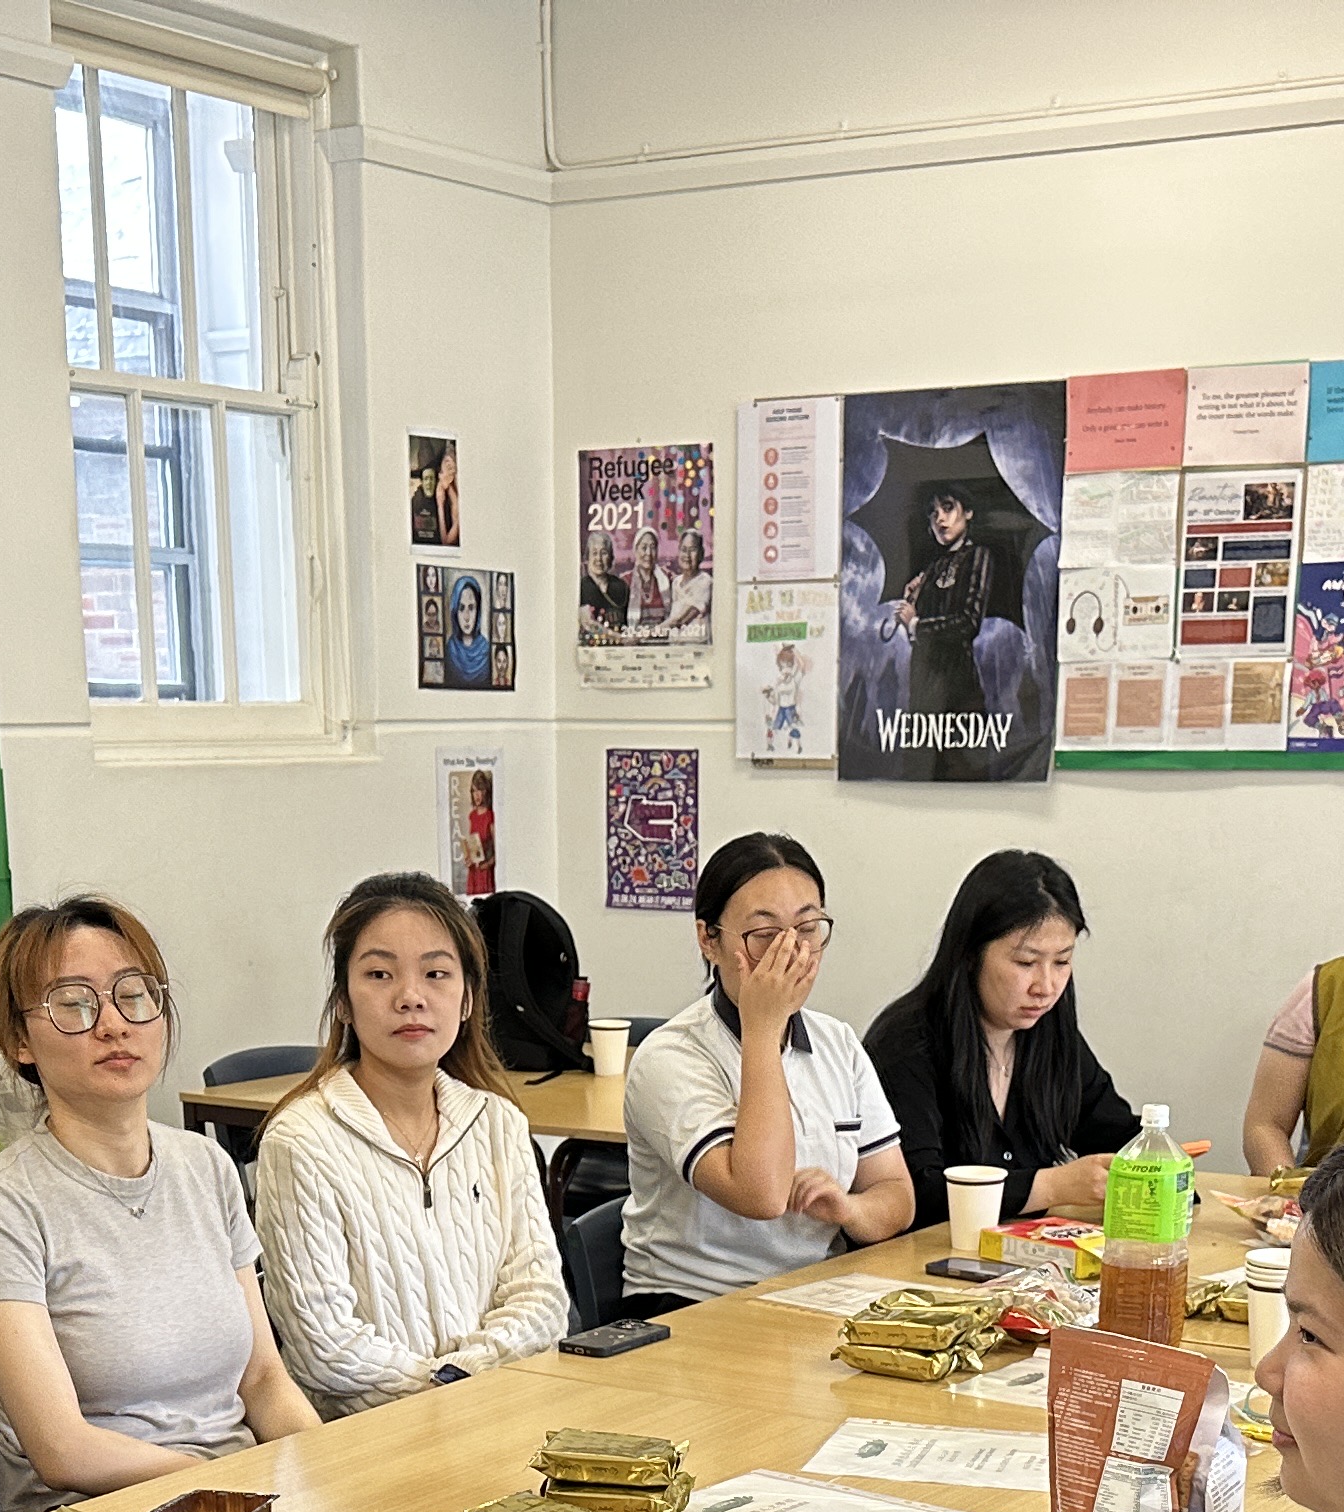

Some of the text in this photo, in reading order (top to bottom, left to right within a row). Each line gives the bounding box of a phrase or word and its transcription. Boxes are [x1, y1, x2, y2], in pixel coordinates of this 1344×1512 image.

[588, 456, 674, 482] Refugee
[589, 480, 645, 501] Week
[588, 502, 644, 531] 2021
[654, 625, 678, 639] June
[680, 625, 706, 638] 2021
[876, 708, 1013, 752] WEDNESDAY
[1131, 1165, 1162, 1173] ITO EN
